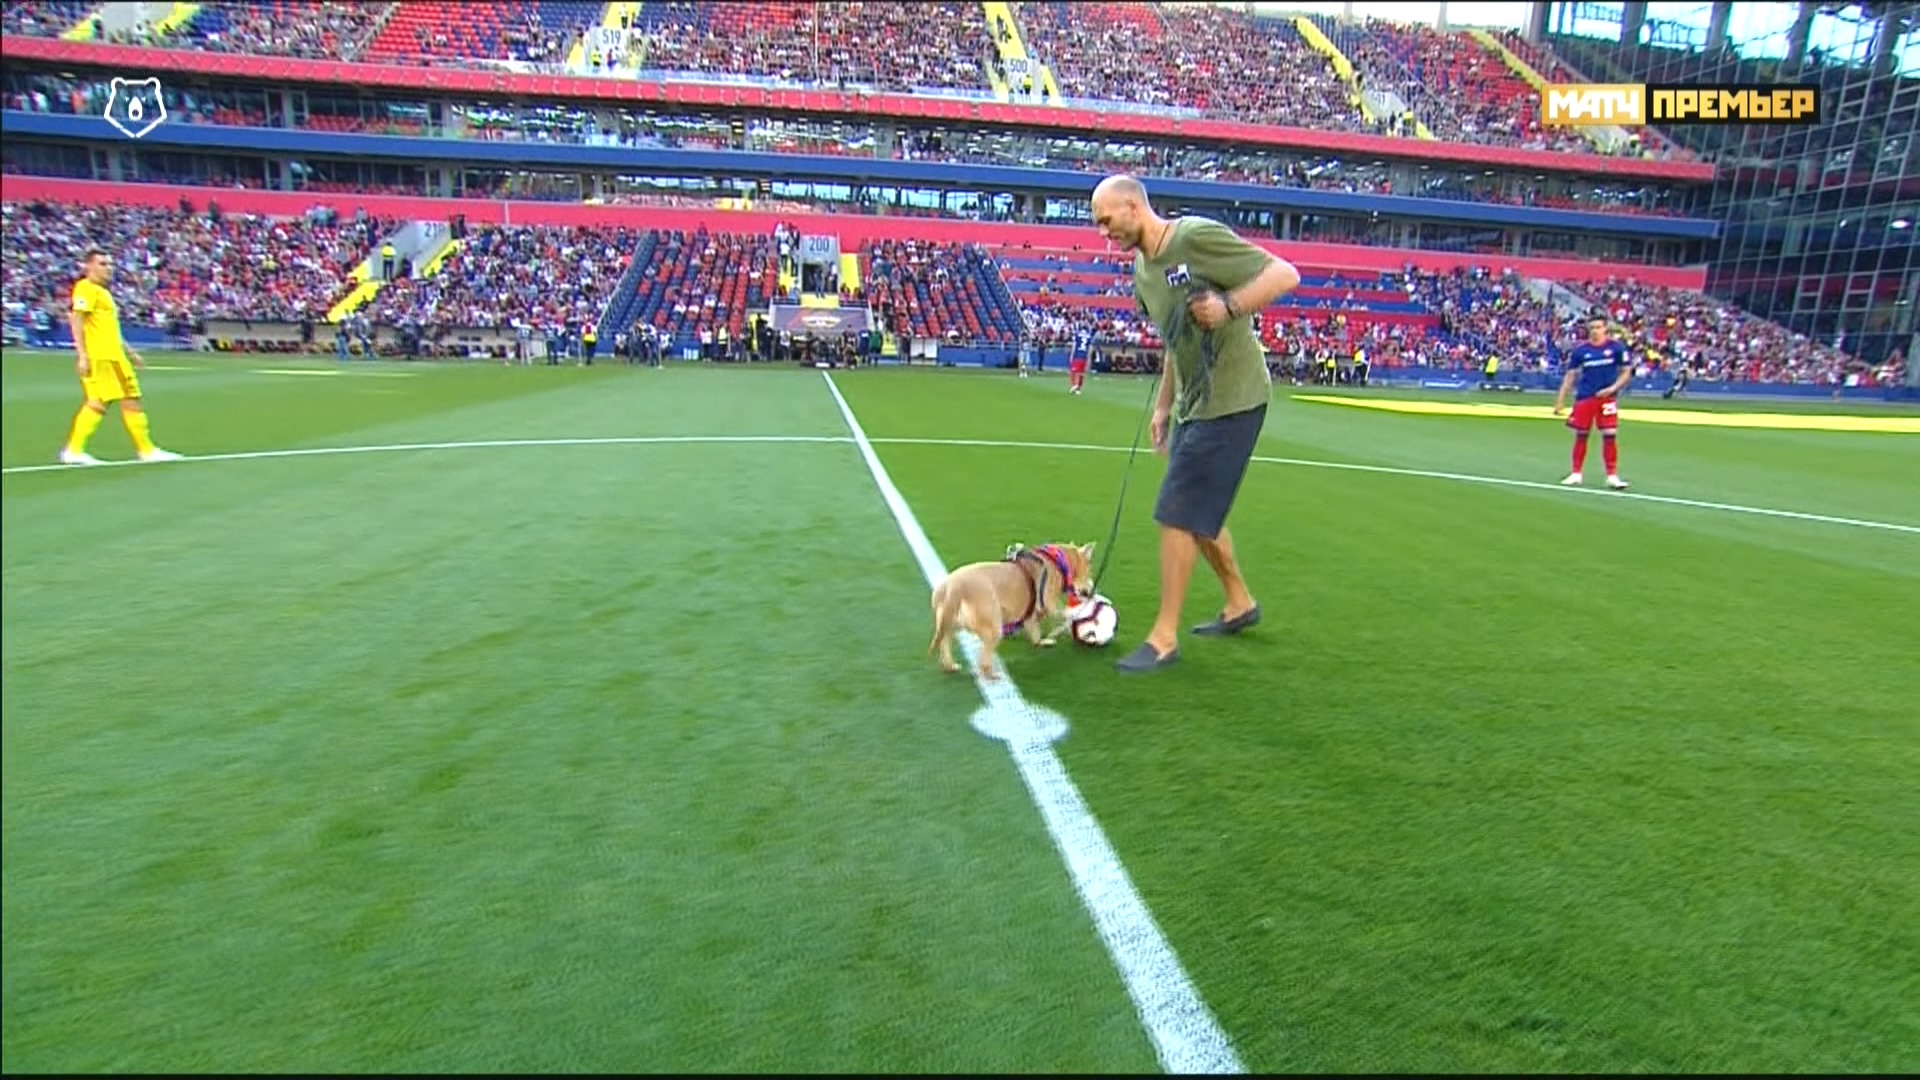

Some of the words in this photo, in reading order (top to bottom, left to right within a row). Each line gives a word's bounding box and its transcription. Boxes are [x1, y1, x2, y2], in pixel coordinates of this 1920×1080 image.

[602, 29, 621, 44] 519
[1010, 58, 1028, 73] 500
[809, 236, 830, 252] 200
